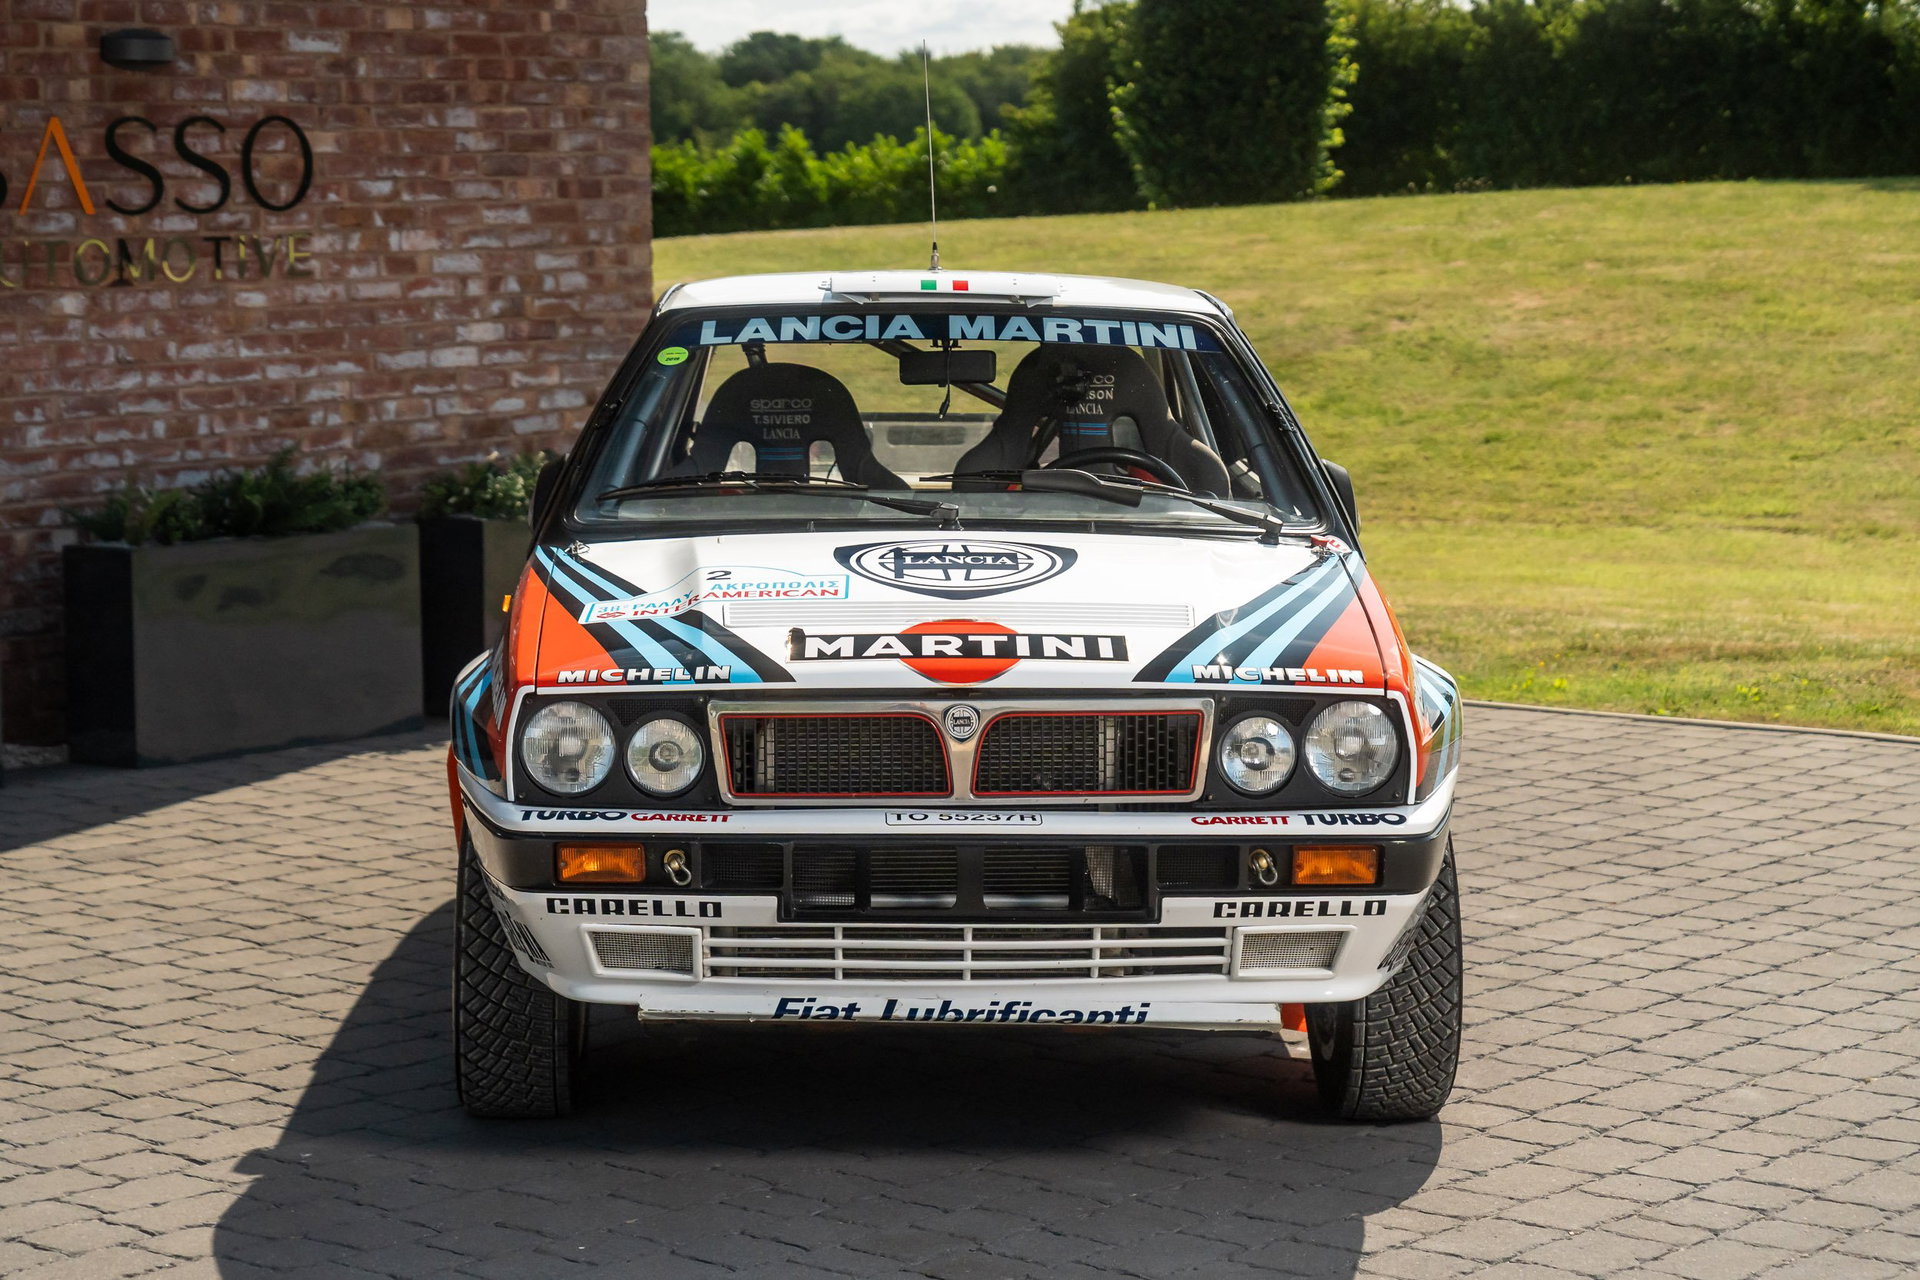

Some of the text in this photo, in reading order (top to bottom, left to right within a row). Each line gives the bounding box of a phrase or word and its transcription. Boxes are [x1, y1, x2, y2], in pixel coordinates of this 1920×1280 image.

[0, 115, 313, 216] ASSO
[0, 234, 313, 287] UTOMOTIVE
[699, 314, 1198, 350] LANCIA MARTINI
[763, 427, 800, 440] LANCIA
[903, 555, 1018, 565] LANCIA
[705, 570, 732, 581] 2
[804, 635, 1114, 659] MARTINI
[557, 665, 732, 684] MICHELIN
[1192, 665, 1365, 684] MICHELIN
[520, 810, 733, 822] TURBO GARRETT
[891, 813, 929, 821] TO
[1191, 813, 1407, 826] GARRETT TURBO
[546, 898, 722, 918] CARELLO
[1213, 900, 1387, 918] CARELLO
[771, 997, 1151, 1024] Fiat Lubrificanti
